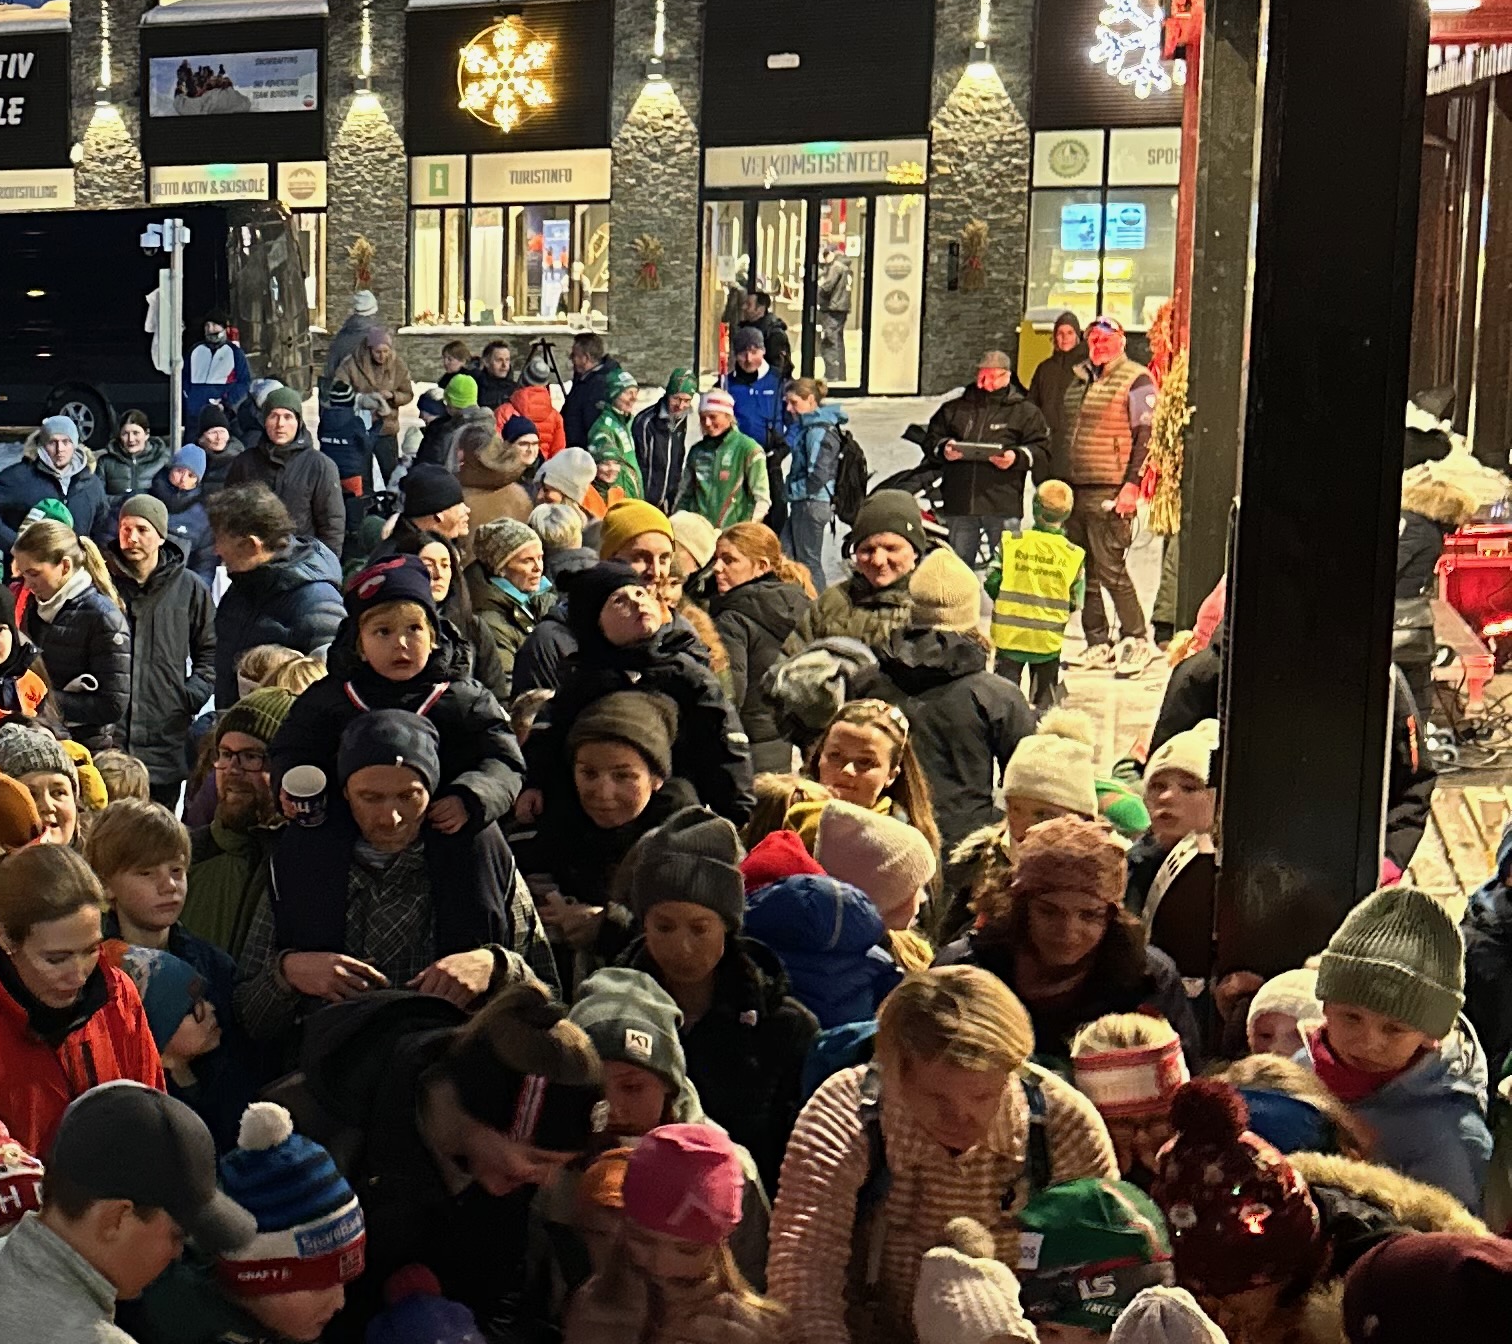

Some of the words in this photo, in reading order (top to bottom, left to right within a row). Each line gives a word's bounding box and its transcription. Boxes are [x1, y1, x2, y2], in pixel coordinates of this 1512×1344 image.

[509, 167, 573, 186] TURISTINFO
[181, 179, 208, 195] AKTIV
[210, 179, 219, 194] &
[220, 177, 265, 194] SKISKOLE
